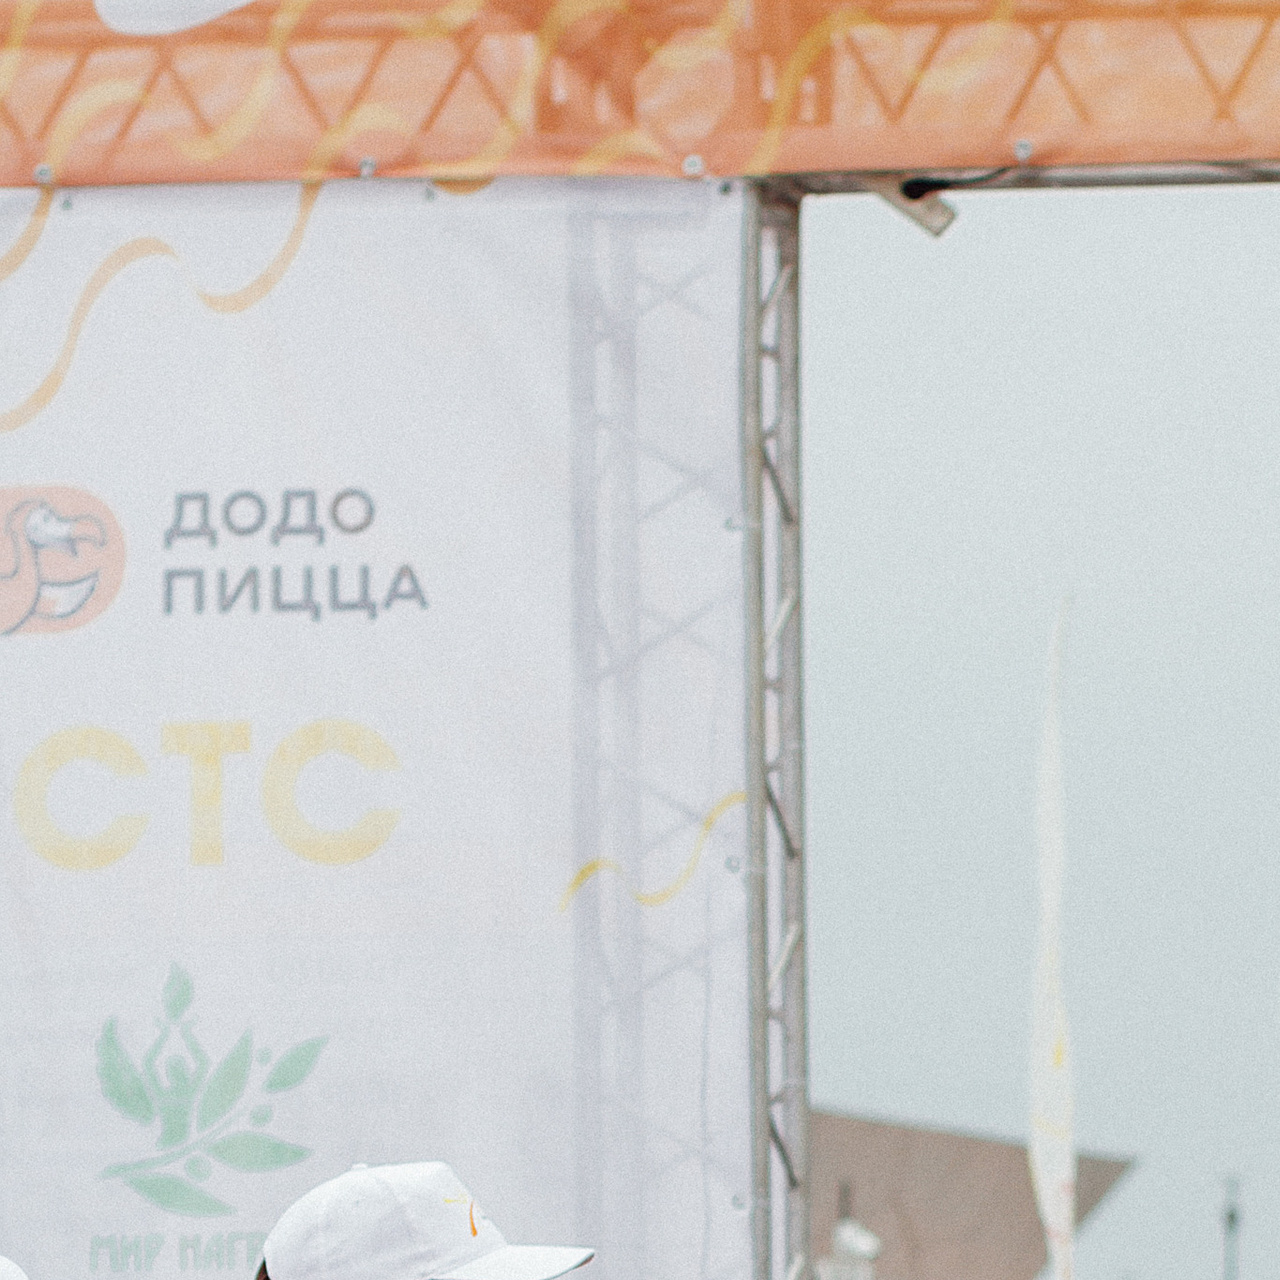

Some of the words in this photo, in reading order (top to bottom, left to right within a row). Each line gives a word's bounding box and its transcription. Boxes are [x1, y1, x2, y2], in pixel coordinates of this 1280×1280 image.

[164, 487, 376, 549] ДОДО
[163, 563, 430, 622] ПИЦЦА
[13, 717, 403, 871] СТС
[90, 1232, 165, 1272] МИР
